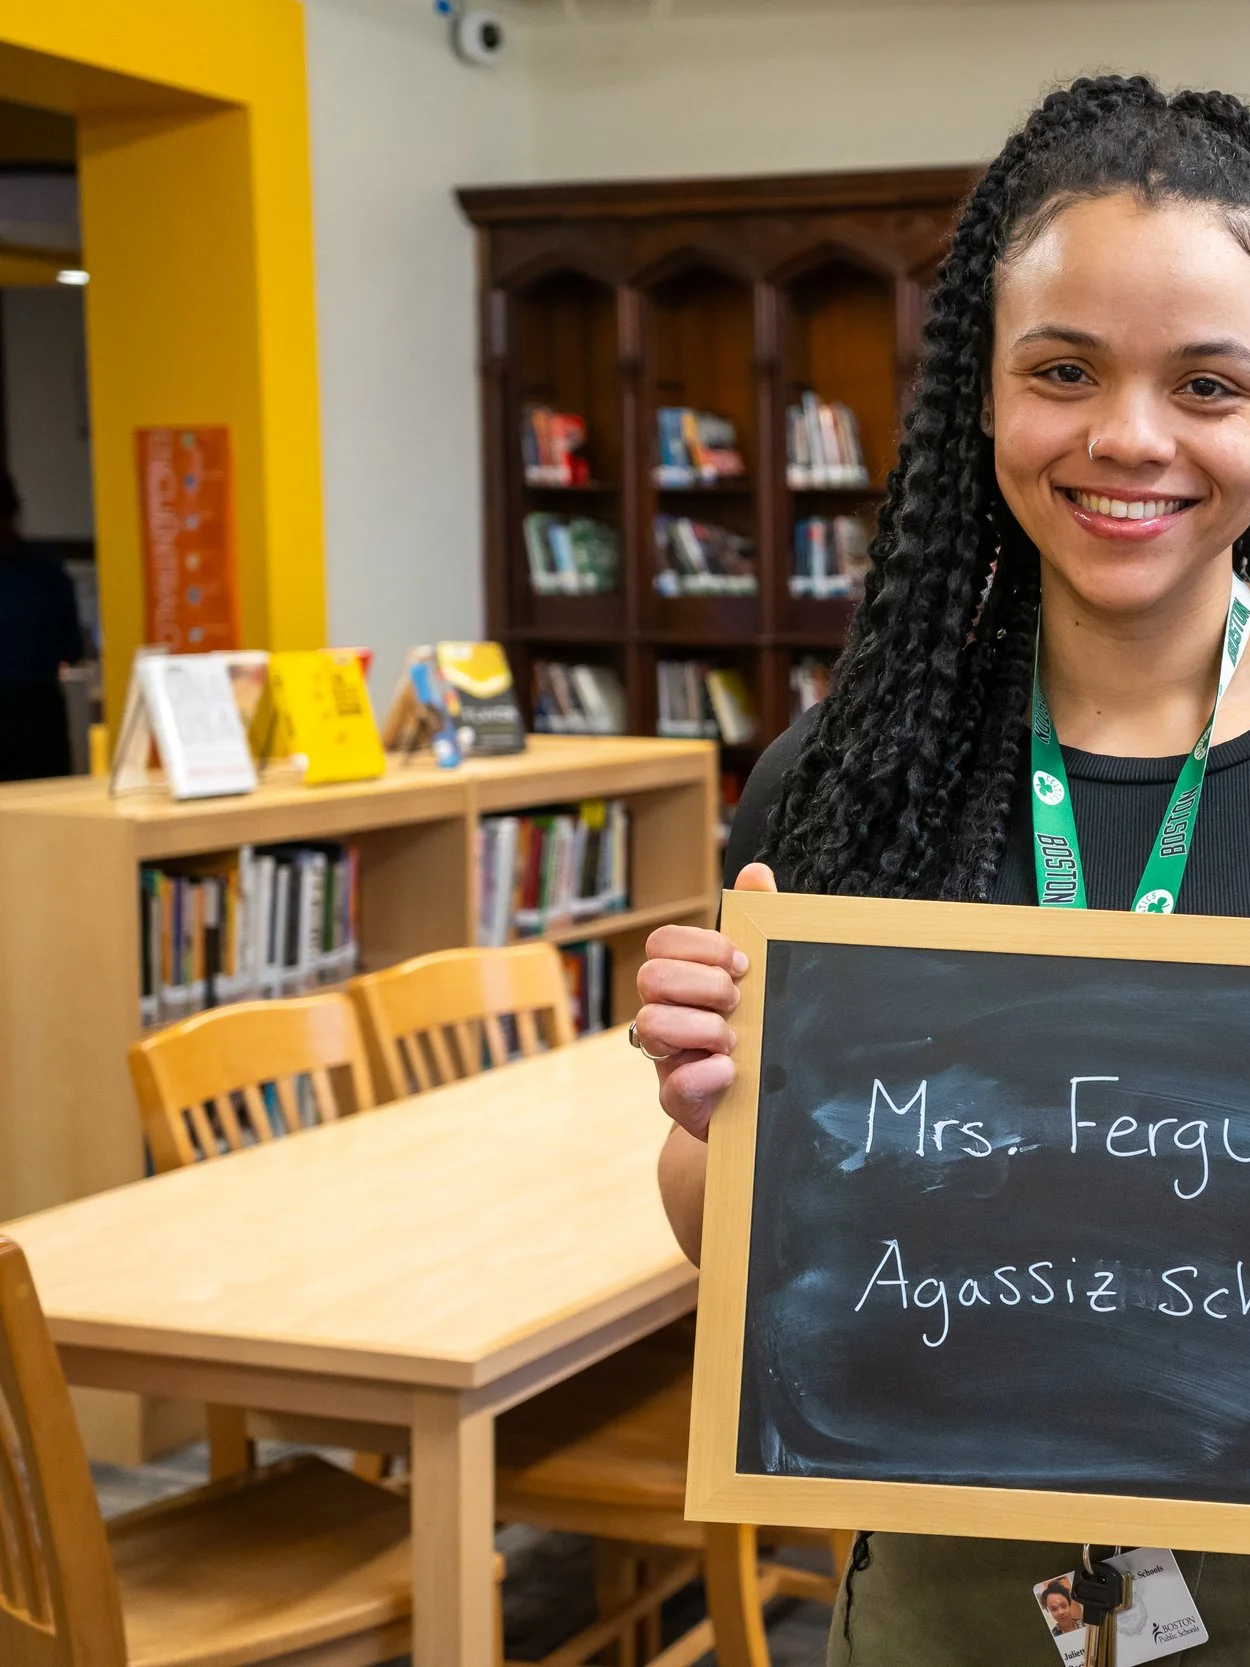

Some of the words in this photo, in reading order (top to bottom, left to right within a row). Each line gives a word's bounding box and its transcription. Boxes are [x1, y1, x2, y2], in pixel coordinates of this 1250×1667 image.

[1159, 783, 1200, 858] BOSTON
[1036, 833, 1079, 905] BOSTON
[1138, 892, 1157, 913] TICS
[864, 1077, 1019, 1158] Mrs.
[854, 1239, 1118, 1348] Agassiz
[1137, 1565, 1164, 1579] Schools
[1158, 1632, 1177, 1645] Public
[1178, 1625, 1200, 1639] Schools
[1162, 1615, 1196, 1632] BOSTON
